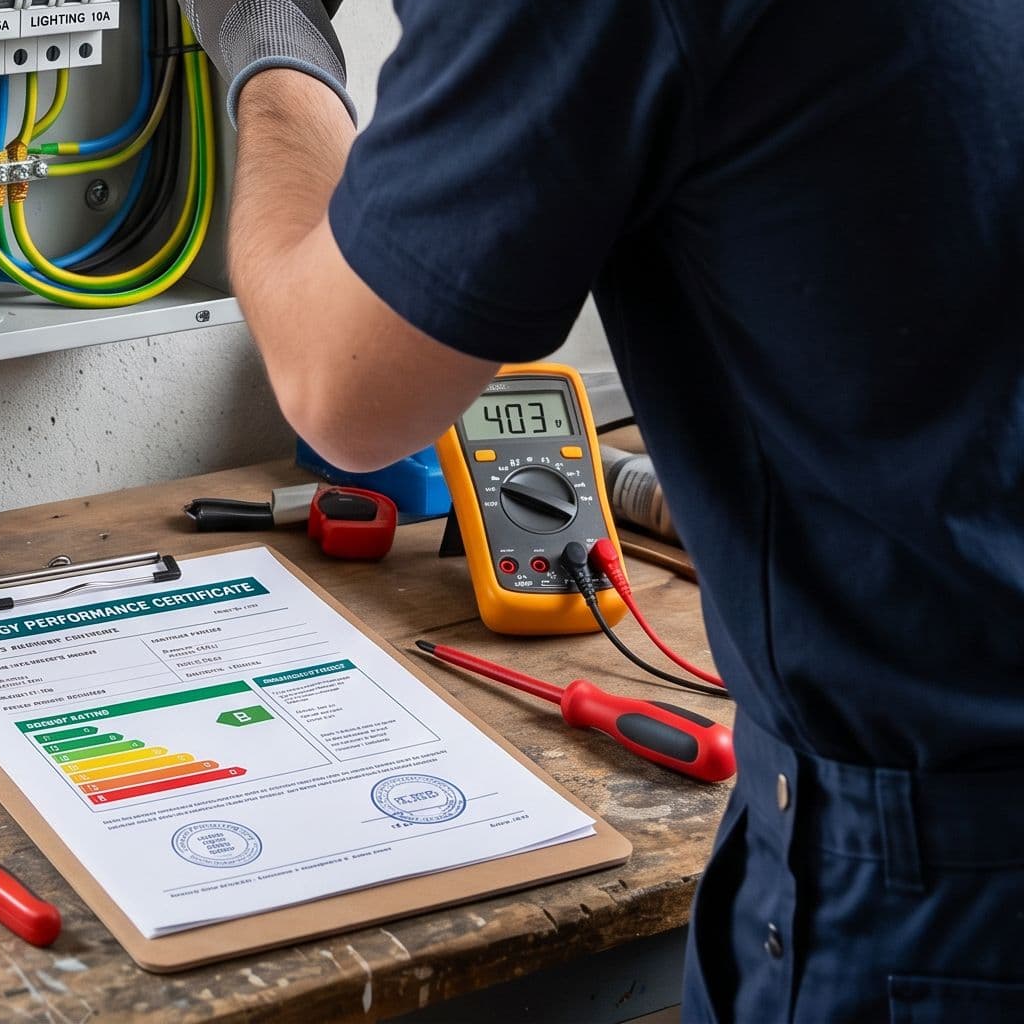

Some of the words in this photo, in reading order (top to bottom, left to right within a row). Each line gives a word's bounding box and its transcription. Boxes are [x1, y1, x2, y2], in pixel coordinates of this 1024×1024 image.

[30, 12, 86, 28] LIGHTING
[90, 11, 111, 23] 10A
[484, 403, 547, 434] 403
[25, 599, 149, 631] PERFORMANCE
[151, 581, 254, 609] CERTIFICATE
